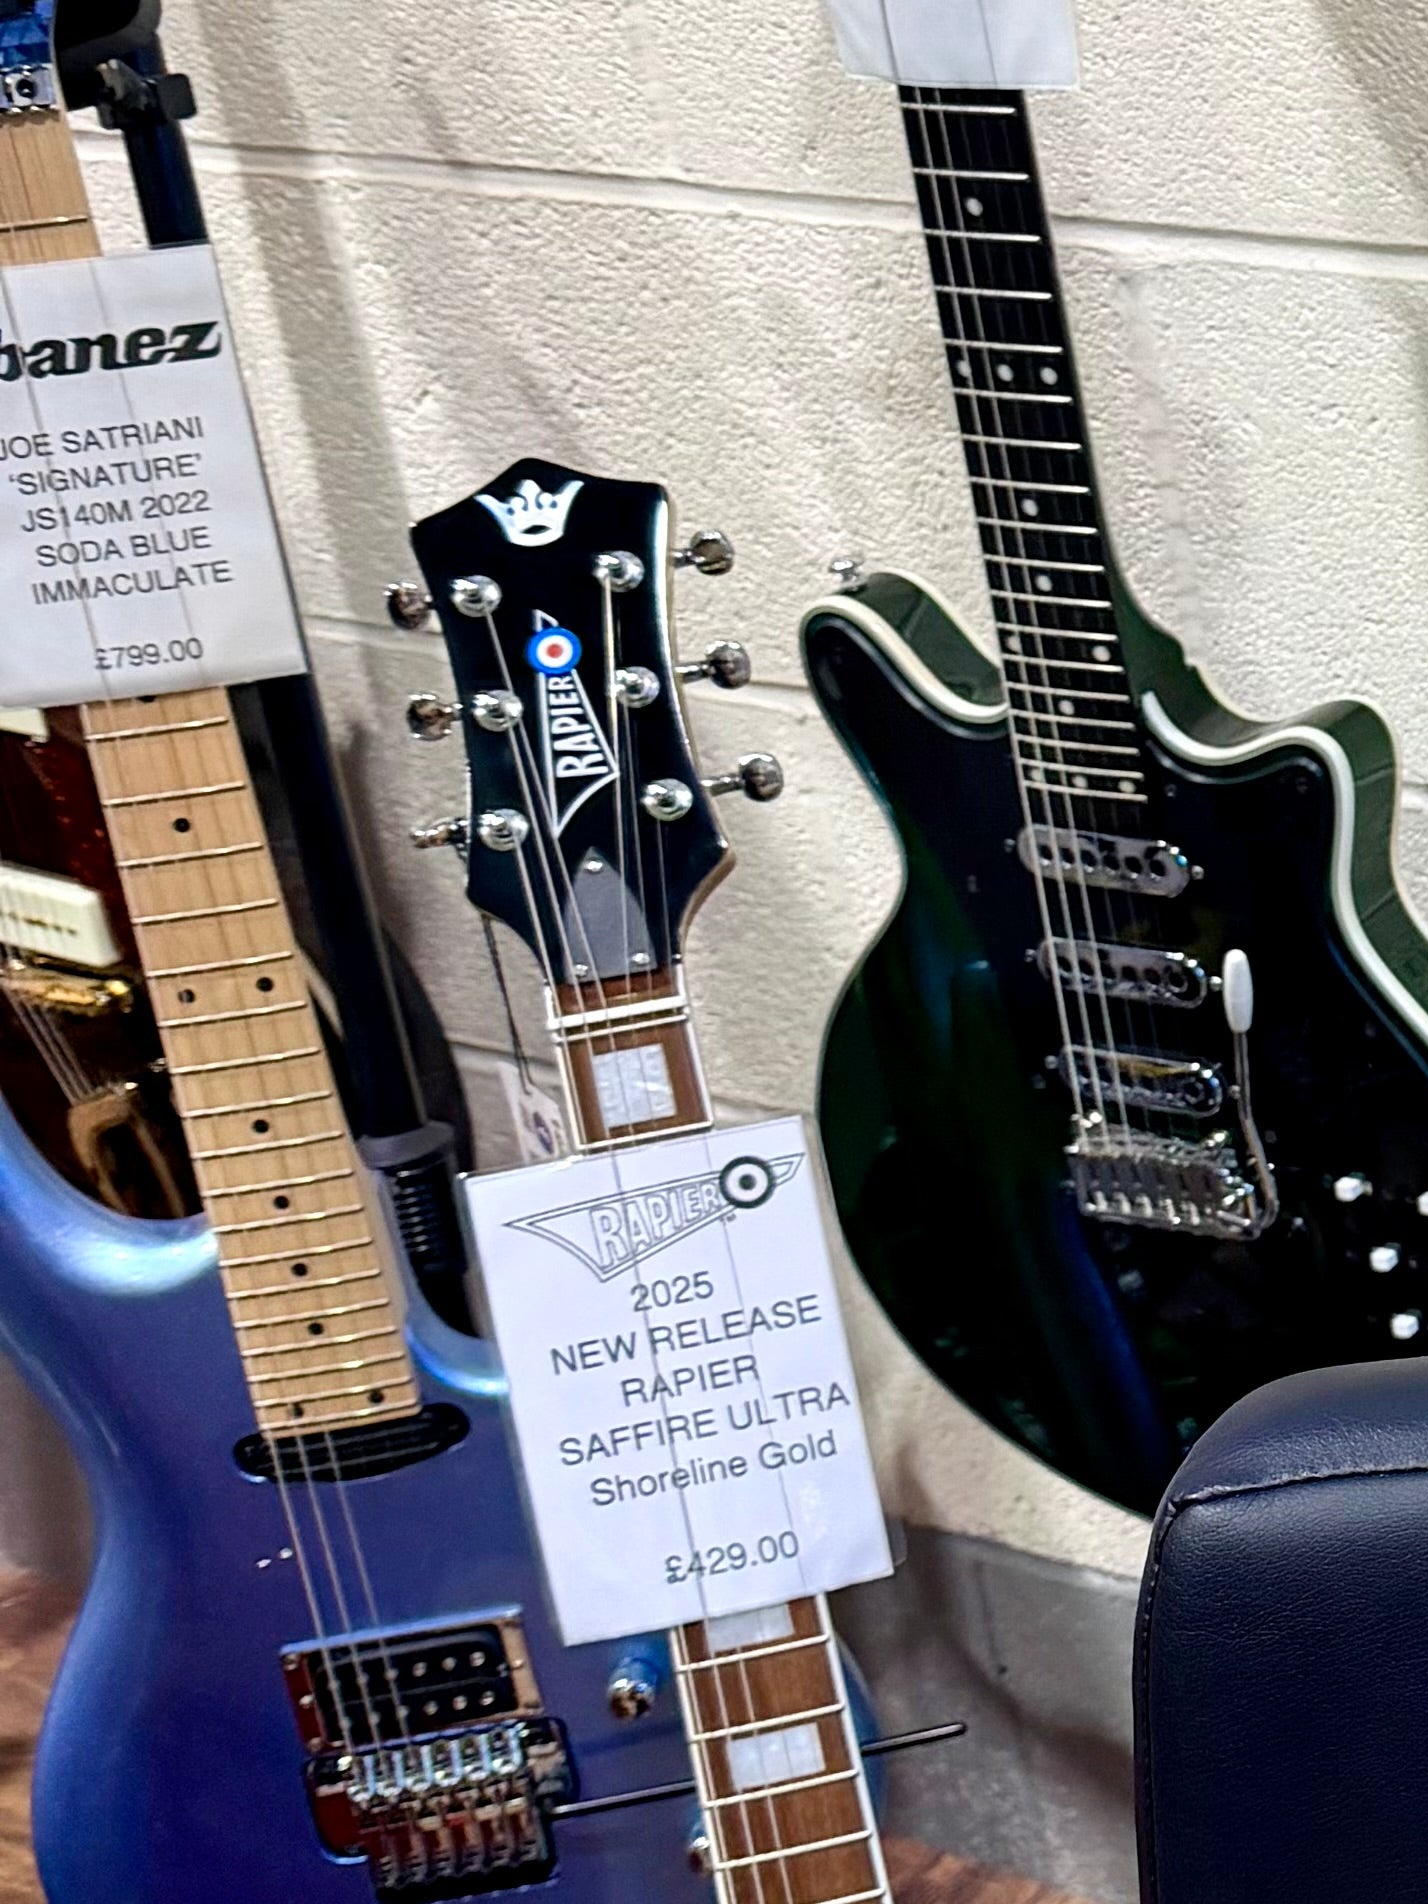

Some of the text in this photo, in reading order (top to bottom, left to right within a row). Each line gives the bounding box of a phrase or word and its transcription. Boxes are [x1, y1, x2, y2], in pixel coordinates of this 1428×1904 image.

[0, 320, 222, 382] banez
[0, 416, 204, 462] JOE SATRIANI
[21, 489, 213, 533] JS140M 2022
[35, 526, 212, 568] SODA BLUE
[32, 559, 234, 606] IMMACULATE
[95, 637, 205, 671] £799.00
[547, 675, 609, 778] RAPIER
[589, 1182, 723, 1271] RAPIER
[629, 1270, 715, 1313] 2025
[550, 1293, 822, 1376] NEW RELEASE
[620, 1353, 760, 1408] RAPIER
[559, 1381, 851, 1467] SAFFIRE ULTRA
[589, 1428, 838, 1507] Shoreline Gold
[664, 1530, 800, 1585] £429.00
